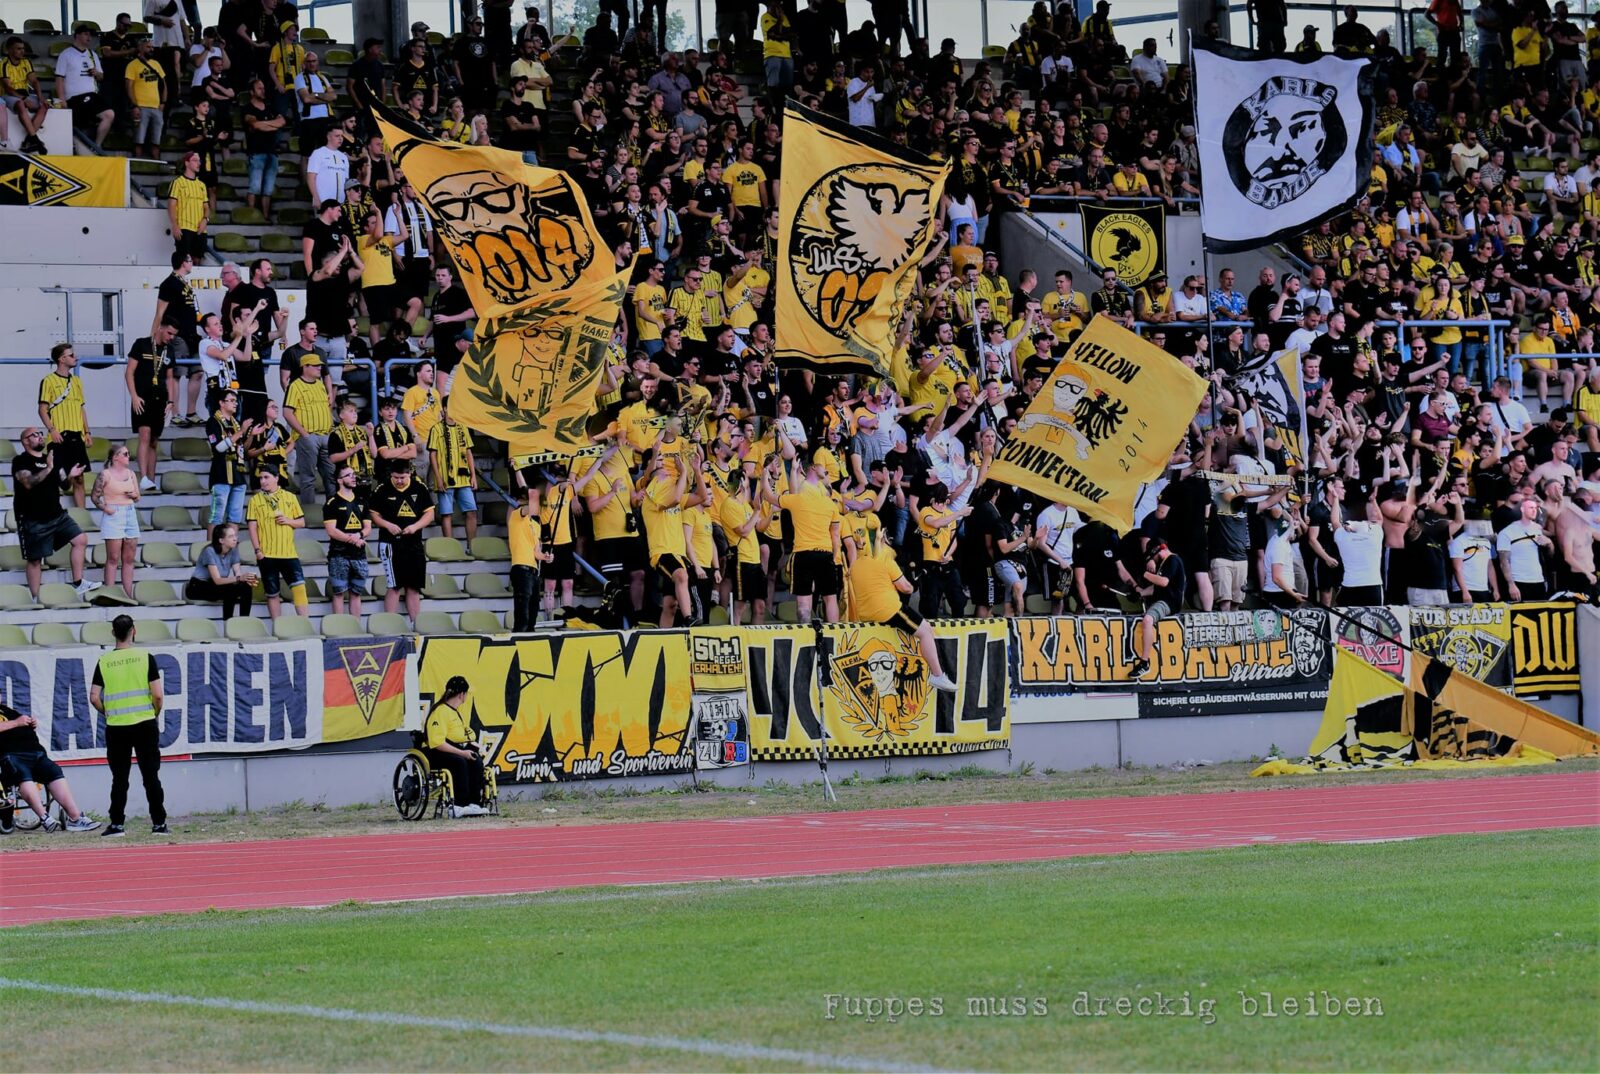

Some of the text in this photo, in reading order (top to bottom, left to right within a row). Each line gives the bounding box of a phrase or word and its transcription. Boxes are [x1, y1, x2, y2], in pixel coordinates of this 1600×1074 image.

[1242, 76, 1338, 121] KARLS
[1246, 159, 1326, 209] BANDE
[1097, 213, 1151, 234] BLACK EAGLES
[1074, 341, 1142, 385] YELLOW
[1118, 418, 1148, 473] 2014
[1449, 608, 1504, 625] STADT
[694, 664, 742, 674] ERHALTEN!
[714, 655, 741, 664] REGEL
[1232, 661, 1296, 682] Ultras
[1153, 696, 1188, 706] SICHERE
[1189, 691, 1293, 705] GEBÄUDEENTWÄSSERUNG
[1294, 691, 1308, 700] MIT
[700, 700, 740, 720] NEIN
[700, 741, 747, 762] ZU RB
[950, 739, 1009, 752] CONNECTION
[573, 752, 602, 775] und
[607, 746, 693, 776] Sportverein
